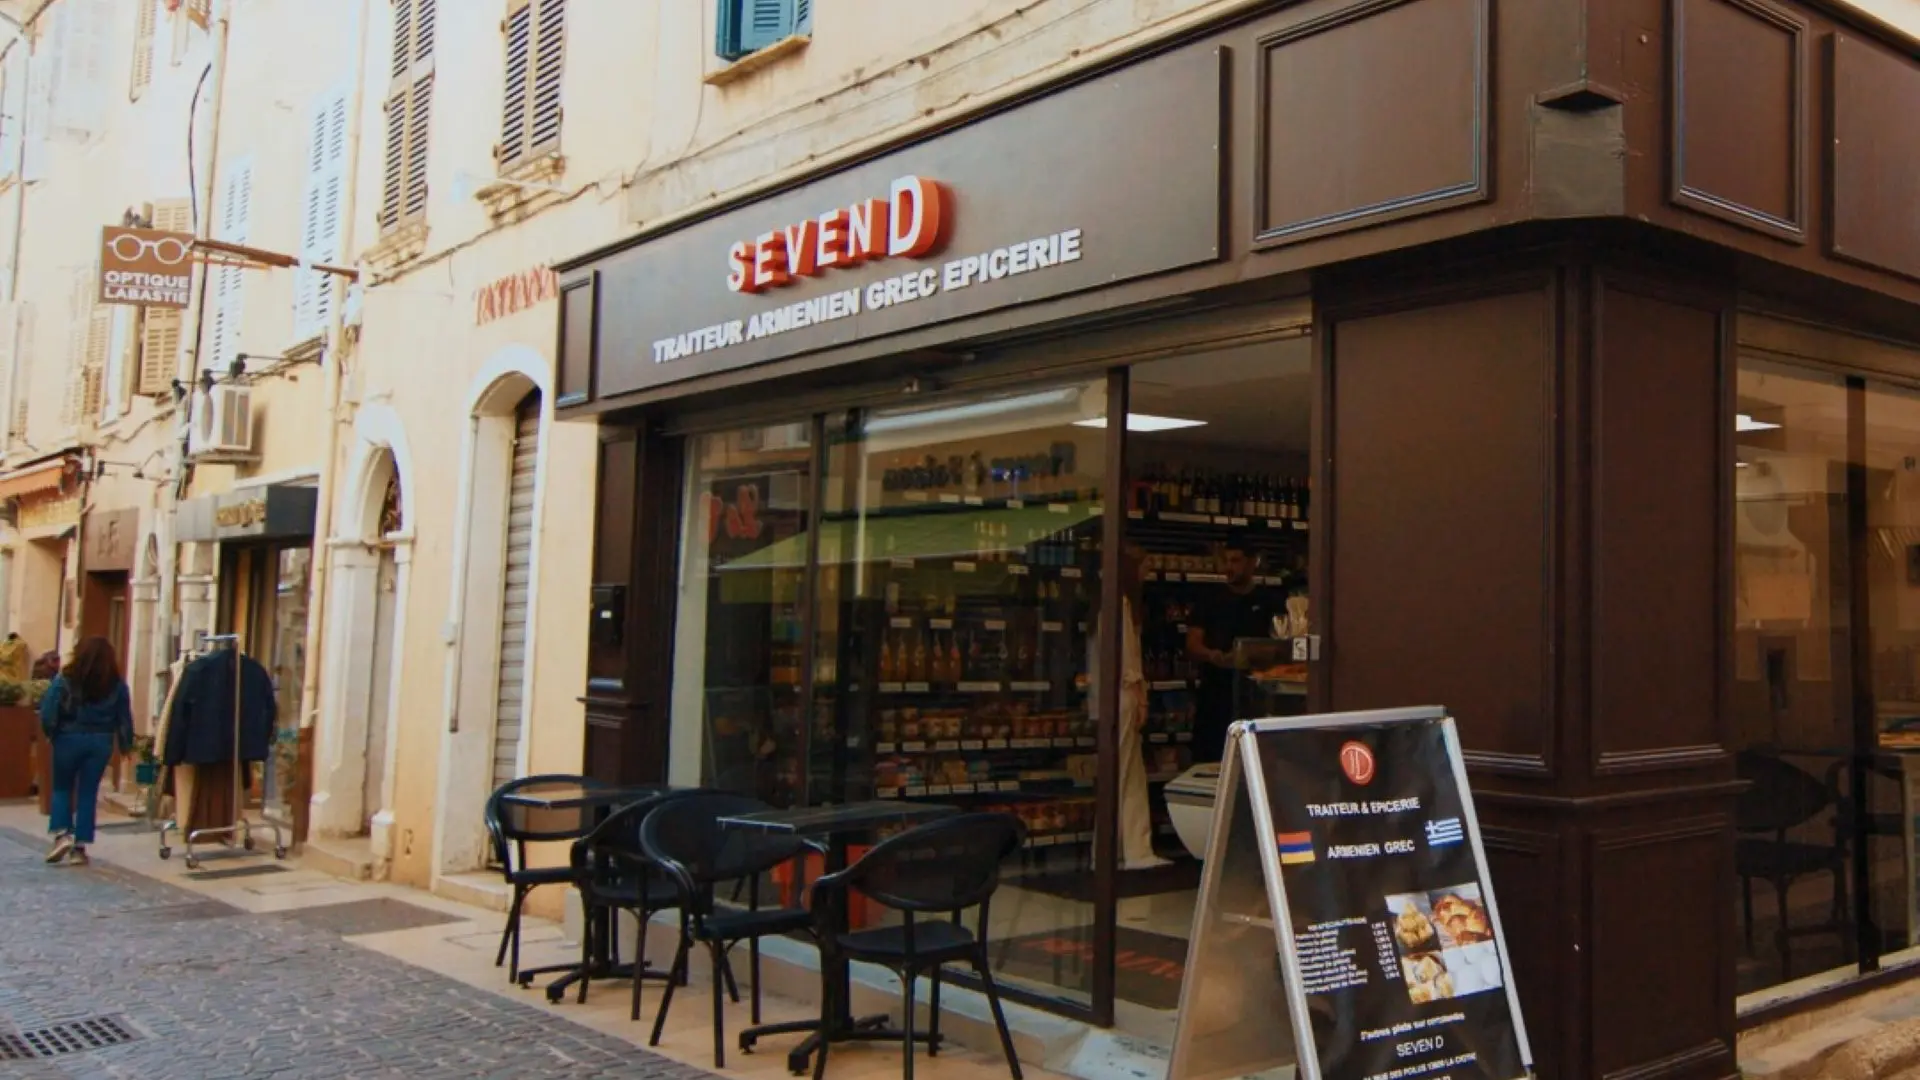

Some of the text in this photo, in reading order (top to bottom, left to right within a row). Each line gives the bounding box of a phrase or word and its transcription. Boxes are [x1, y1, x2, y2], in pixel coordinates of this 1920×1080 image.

[727, 175, 936, 293] SEVEN D
[104, 271, 189, 288] OPTIQUE
[104, 286, 189, 304] LABASTIE
[653, 228, 1083, 363] TRAITEUR ARMENIEN GREC EPICERIE
[1306, 797, 1420, 817] TRAITEUR & EPICERIE
[1327, 839, 1415, 859] ARMENIEN GREC
[1396, 1035, 1444, 1057] SEVEN D
